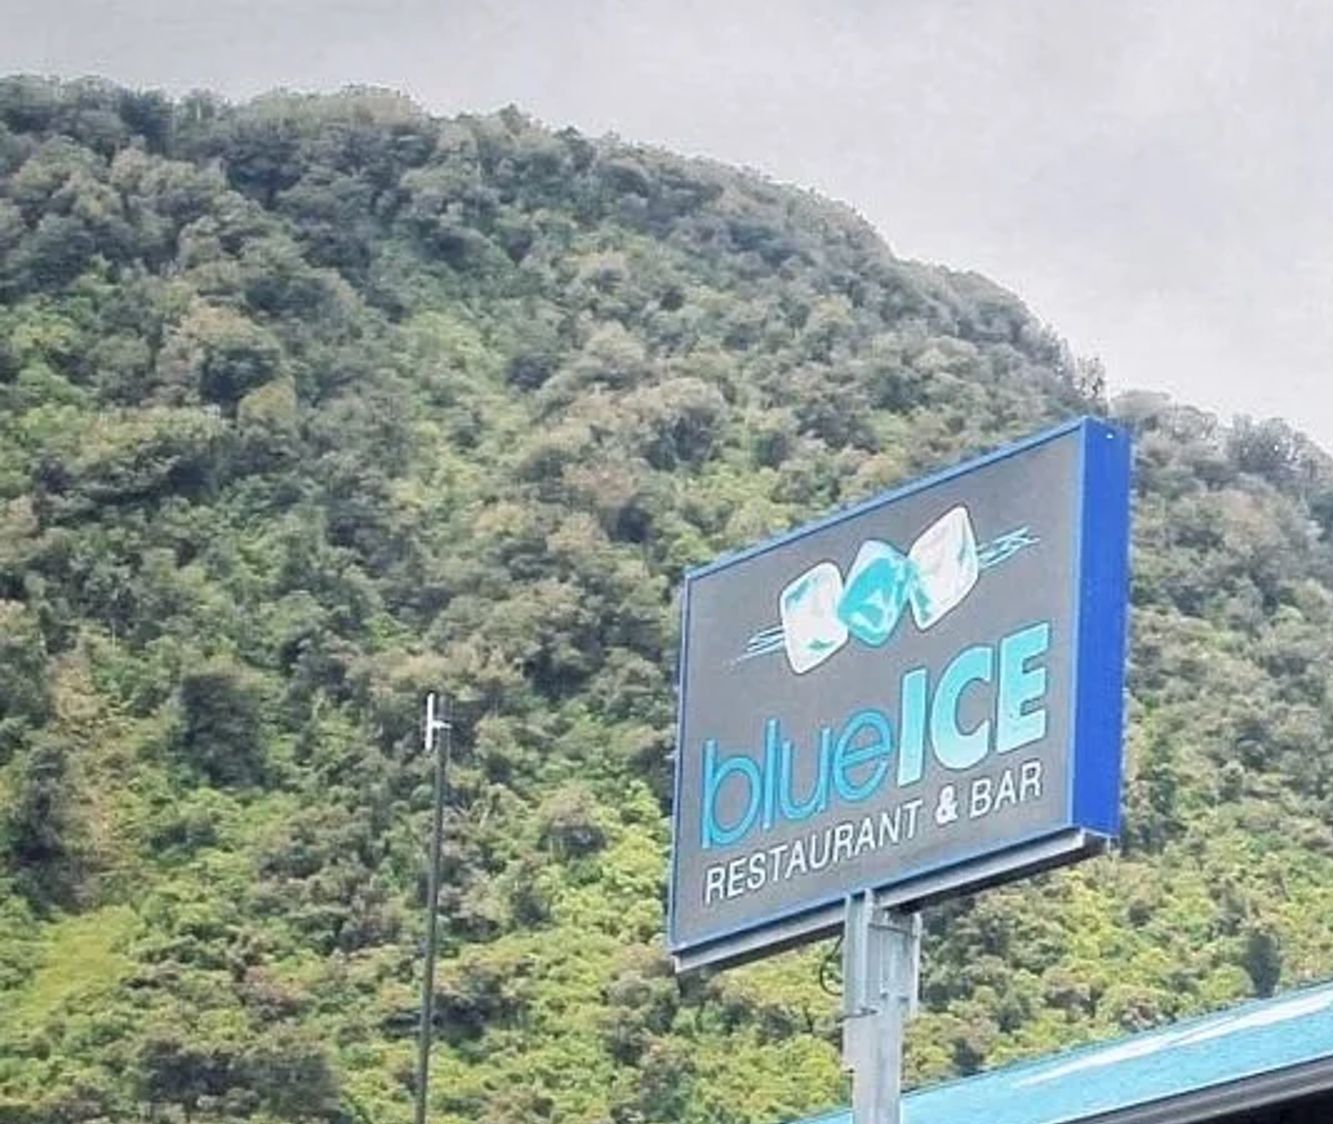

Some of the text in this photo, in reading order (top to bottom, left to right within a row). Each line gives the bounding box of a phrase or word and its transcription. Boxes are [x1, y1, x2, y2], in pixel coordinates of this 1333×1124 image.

[705, 761, 1043, 905] RESTAURANT & BAR
